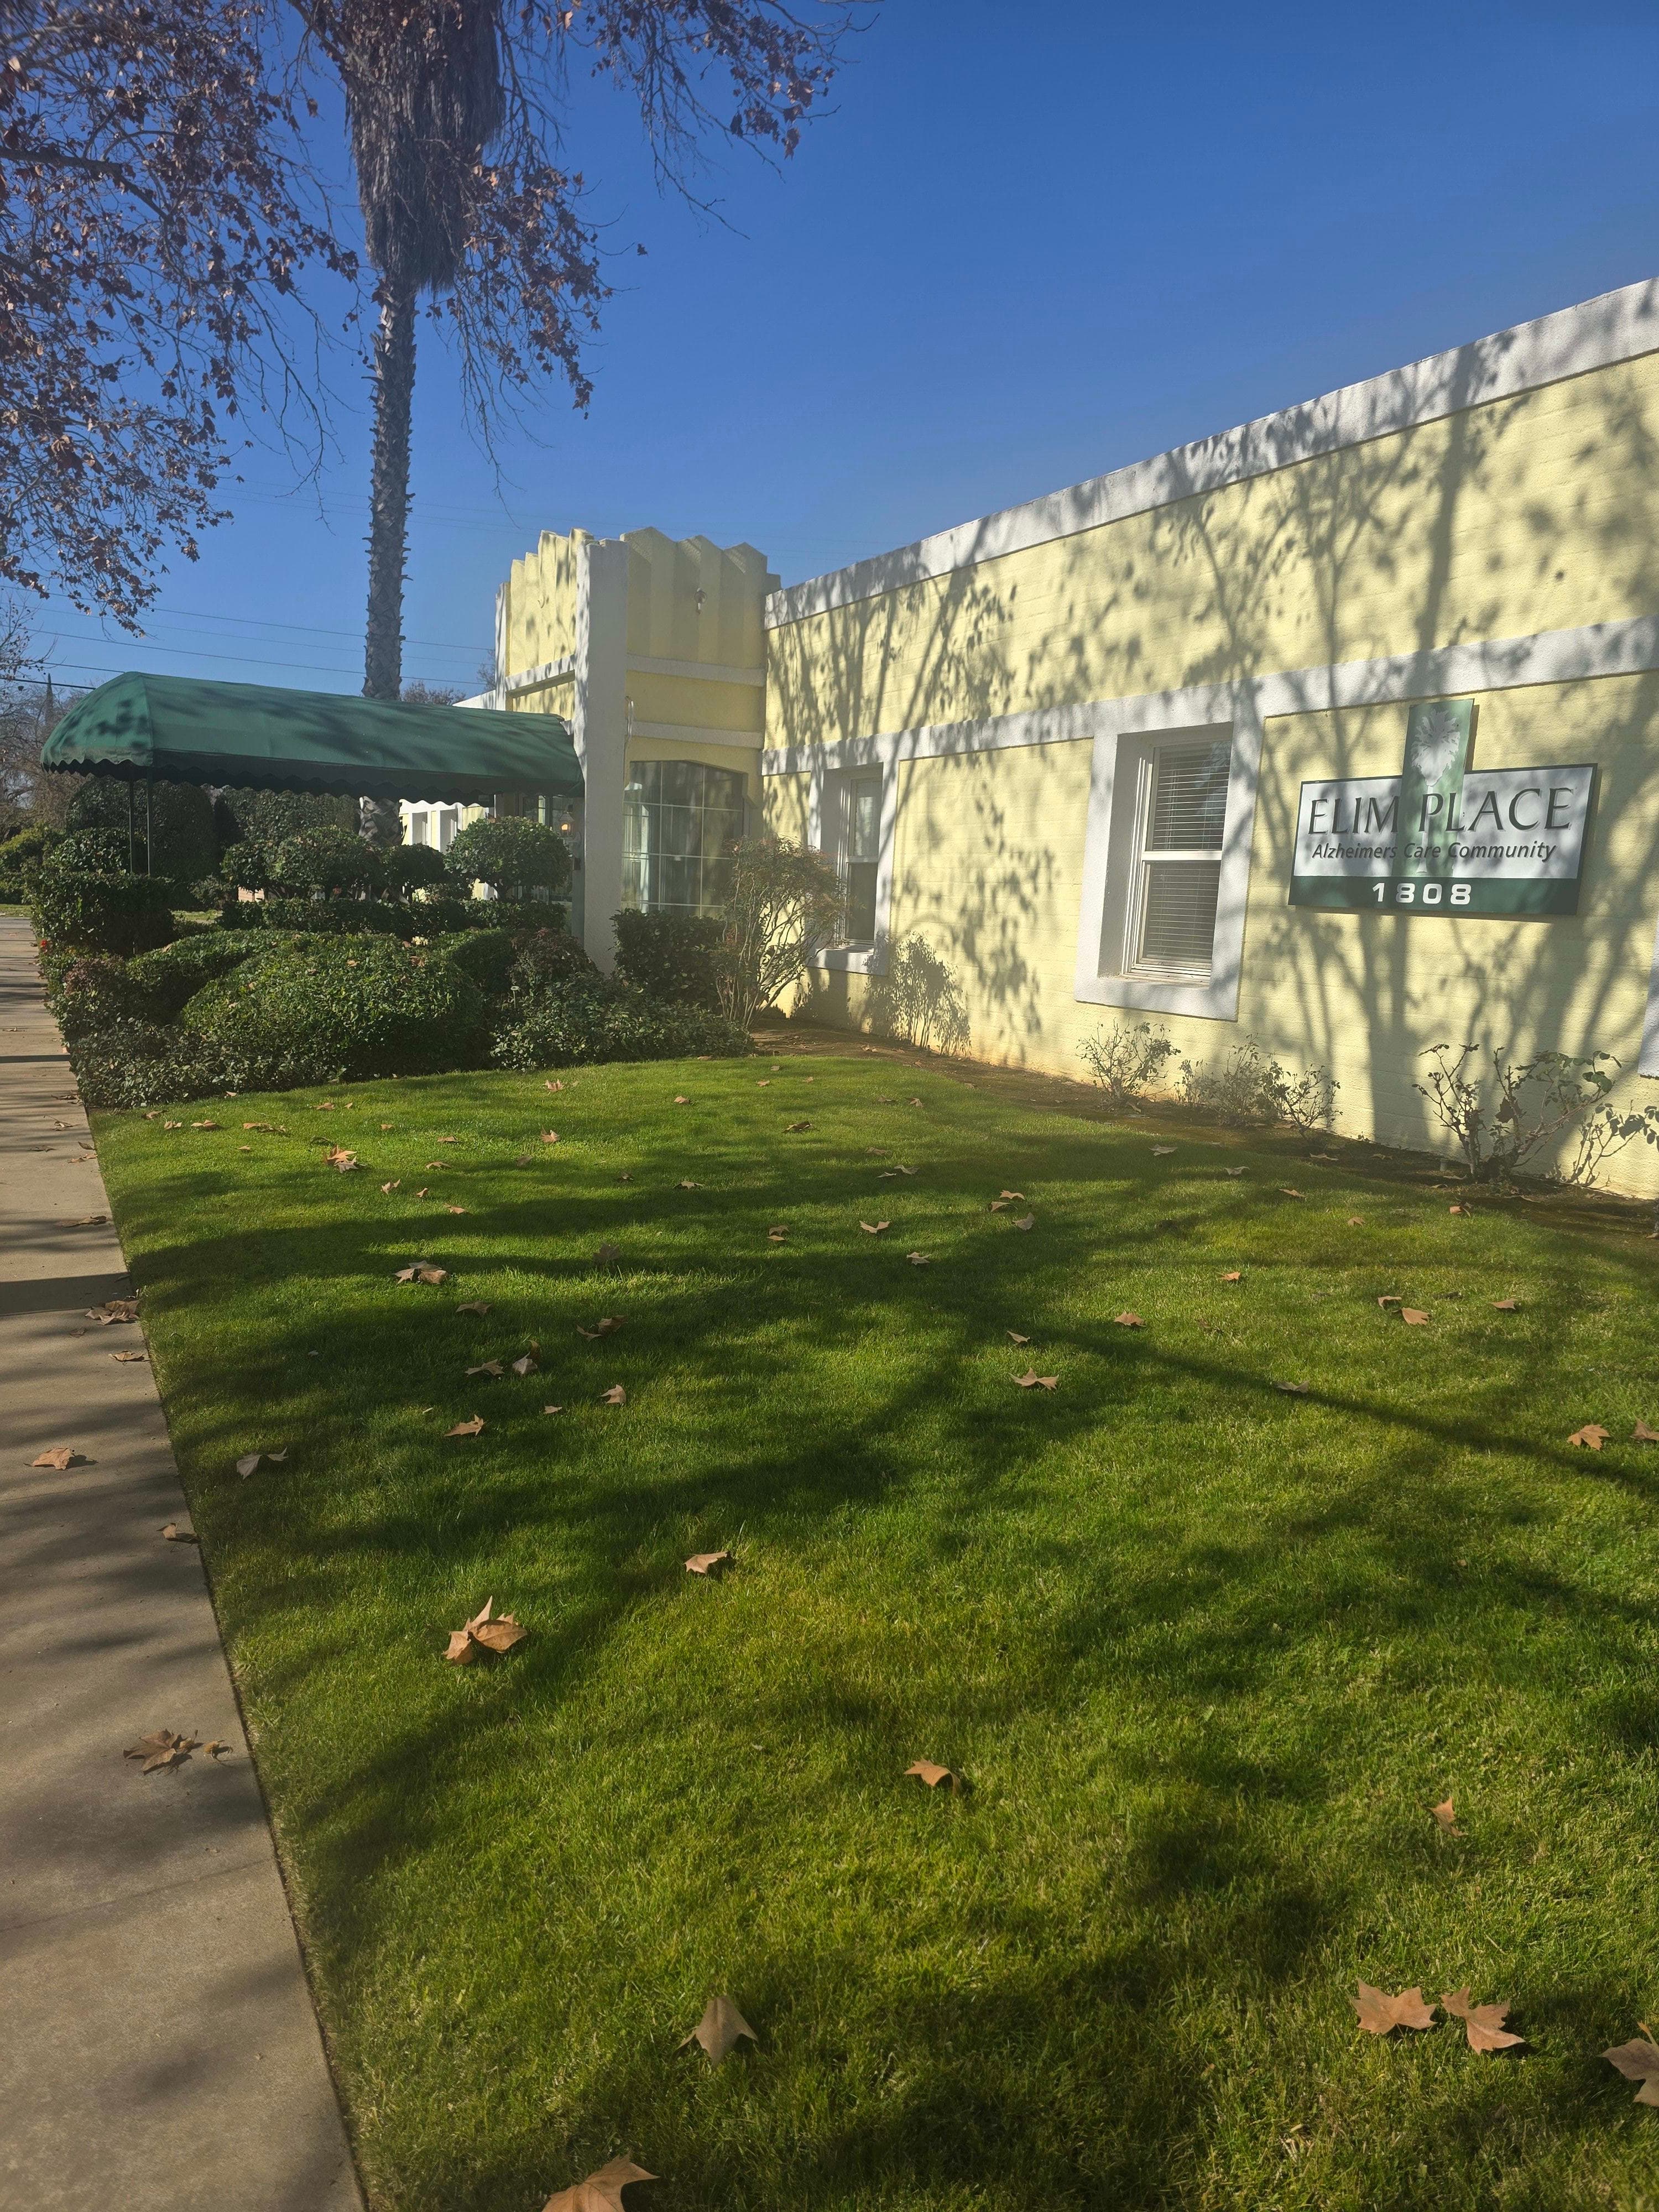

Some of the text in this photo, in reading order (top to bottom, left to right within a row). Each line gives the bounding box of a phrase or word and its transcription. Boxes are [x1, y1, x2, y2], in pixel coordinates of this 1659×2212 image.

[1308, 787, 1572, 834] ELIM PLACE
[1312, 841, 1556, 862] Alzheimers Care Community
[1372, 883, 1472, 905] 1808
